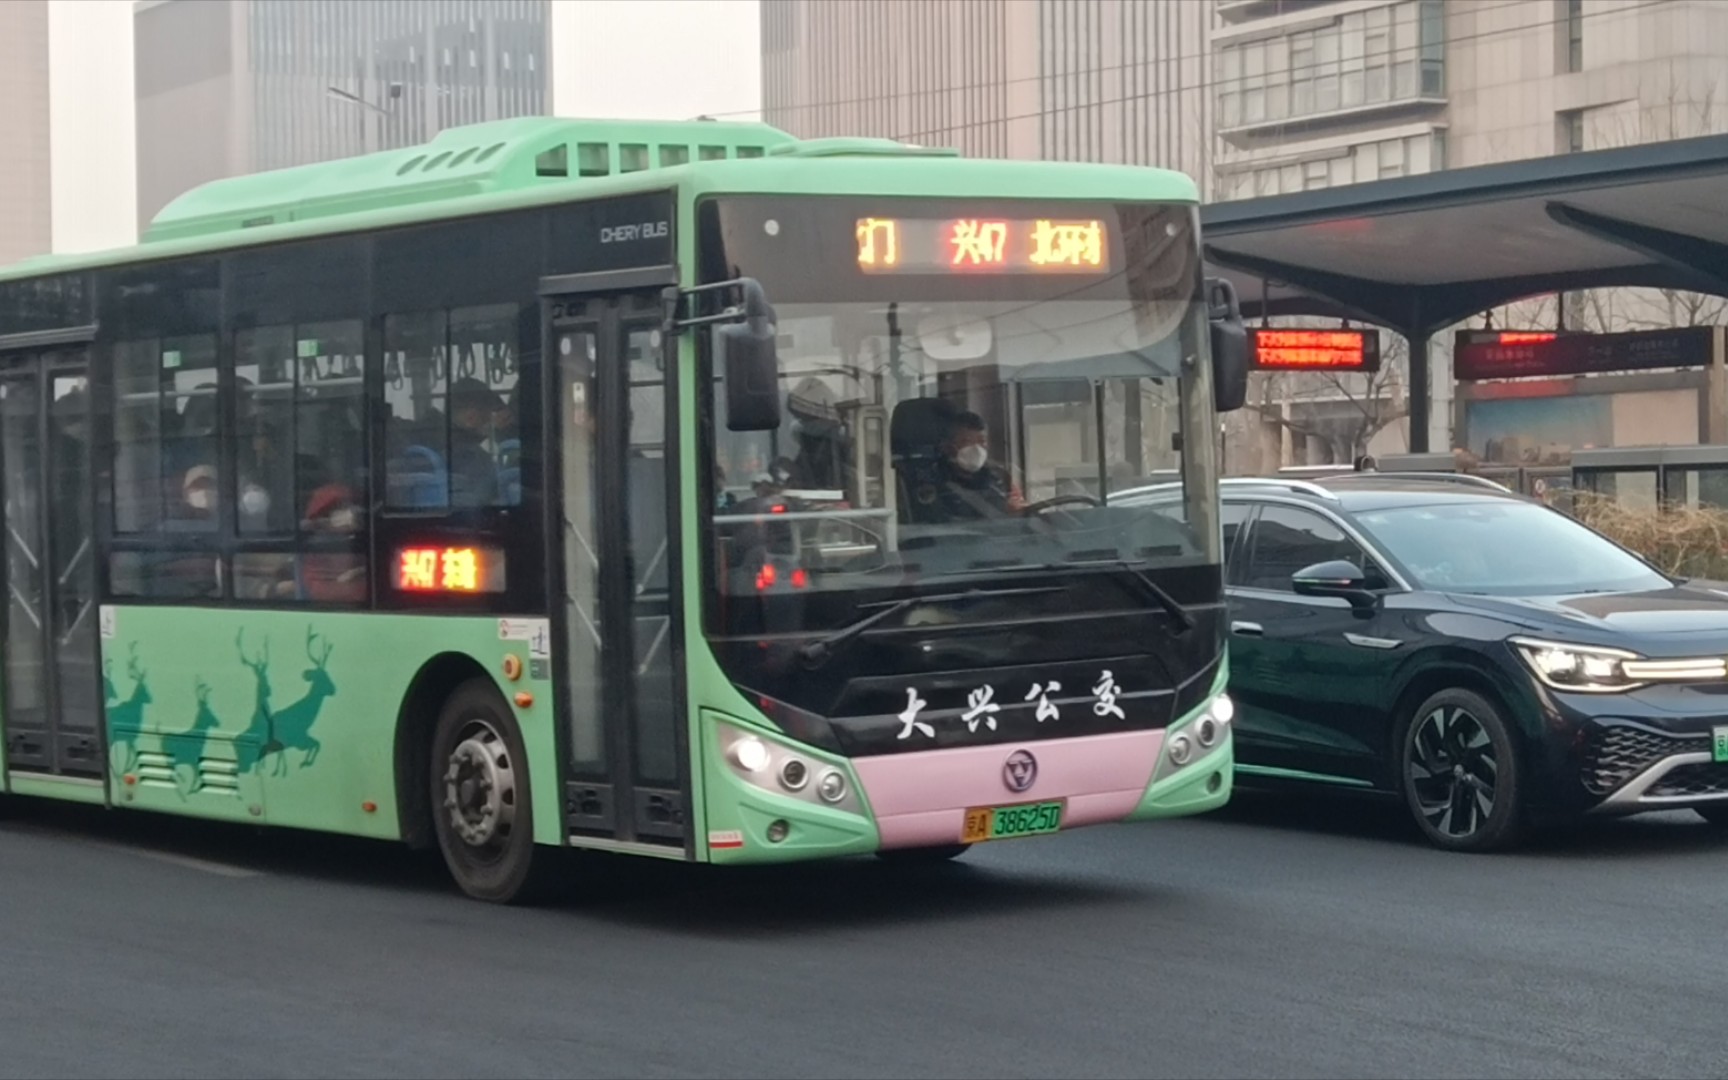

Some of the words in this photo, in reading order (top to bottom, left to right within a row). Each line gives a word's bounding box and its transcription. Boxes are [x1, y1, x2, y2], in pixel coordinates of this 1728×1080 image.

[643, 221, 668, 238] BUS
[896, 669, 1126, 740] 大兴公交
